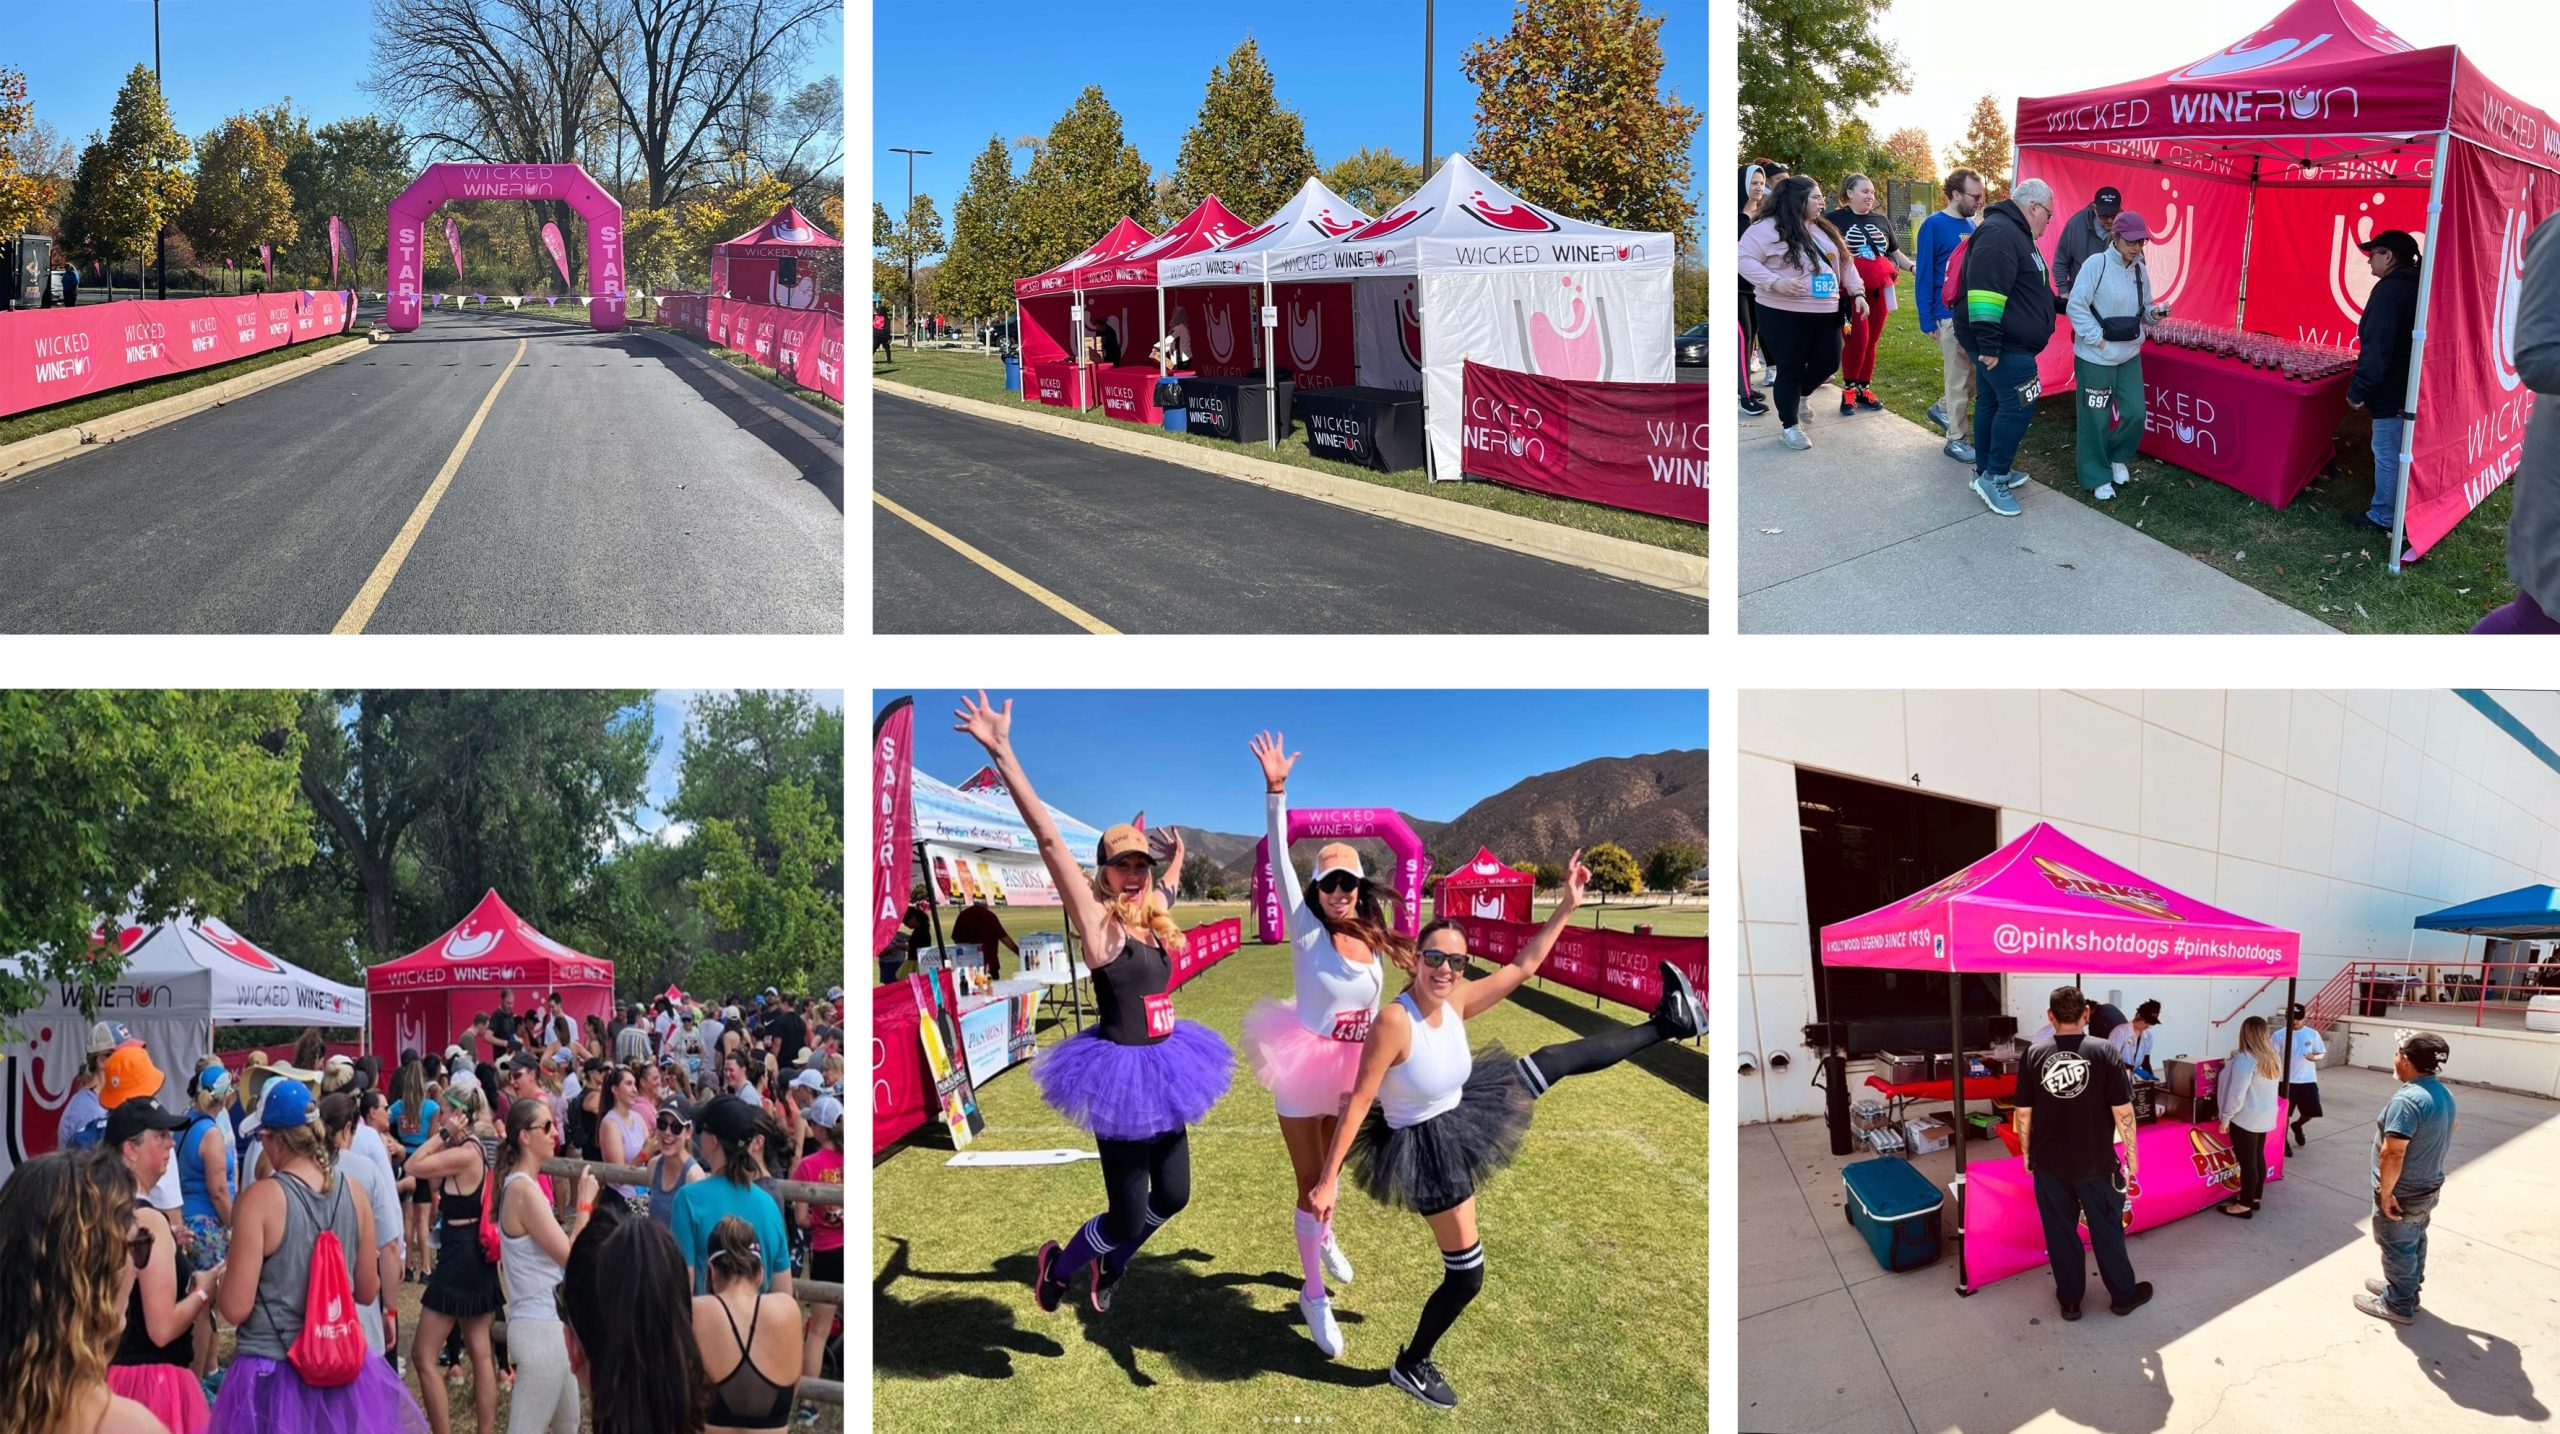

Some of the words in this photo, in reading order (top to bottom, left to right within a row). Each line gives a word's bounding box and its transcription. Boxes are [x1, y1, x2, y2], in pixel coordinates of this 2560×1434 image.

[2046, 98, 2150, 133] WICKED
[2483, 90, 2537, 149] WICKED
[463, 167, 553, 180] WICKED
[745, 248, 790, 257] WICKED
[1281, 252, 1327, 272] WICKED
[1455, 245, 1540, 265] WICKED
[398, 228, 416, 315] START
[600, 226, 619, 313] START
[1087, 269, 1113, 284] WICKED
[1170, 262, 1201, 279] WICKED
[125, 322, 166, 342] WICKED
[189, 316, 217, 334] WICKED
[35, 332, 90, 358] WICKED
[782, 327, 804, 347] WICKED
[821, 336, 844, 362] WICKED
[1040, 378, 1061, 389] WICKED
[1104, 385, 1134, 399] WICKED
[1294, 373, 1334, 390] ICKED
[1188, 396, 1223, 412] WICKED
[2088, 394, 2109, 408] 697
[1464, 394, 1543, 430] ICKED
[1311, 414, 1360, 435] WICKED
[2468, 389, 2533, 465] WICKE
[1464, 426, 1544, 463] NERUN
[1646, 420, 1709, 451] WIC
[1646, 454, 1709, 489] WINE
[1911, 773, 1921, 787] 4
[1308, 810, 1375, 822] WICKED
[1455, 877, 1486, 886] WICKED
[1264, 863, 1279, 932] START
[1405, 858, 1418, 929] START
[1555, 941, 1583, 957] WICKED
[1830, 939, 1861, 952] HOLLYWOOD
[1861, 935, 1884, 950] LEGEND
[1884, 932, 1907, 948] SINCE
[1908, 928, 1931, 947] 1939
[1993, 923, 2169, 959] @pinkshotdogs
[2173, 935, 2282, 965] #pinkshotdogs
[1607, 949, 1649, 971] WICKED
[388, 967, 446, 986] WICKED
[61, 983, 172, 1008] WERUN
[236, 985, 290, 1007] WICKED
[2190, 1148, 2237, 1178] PIN
